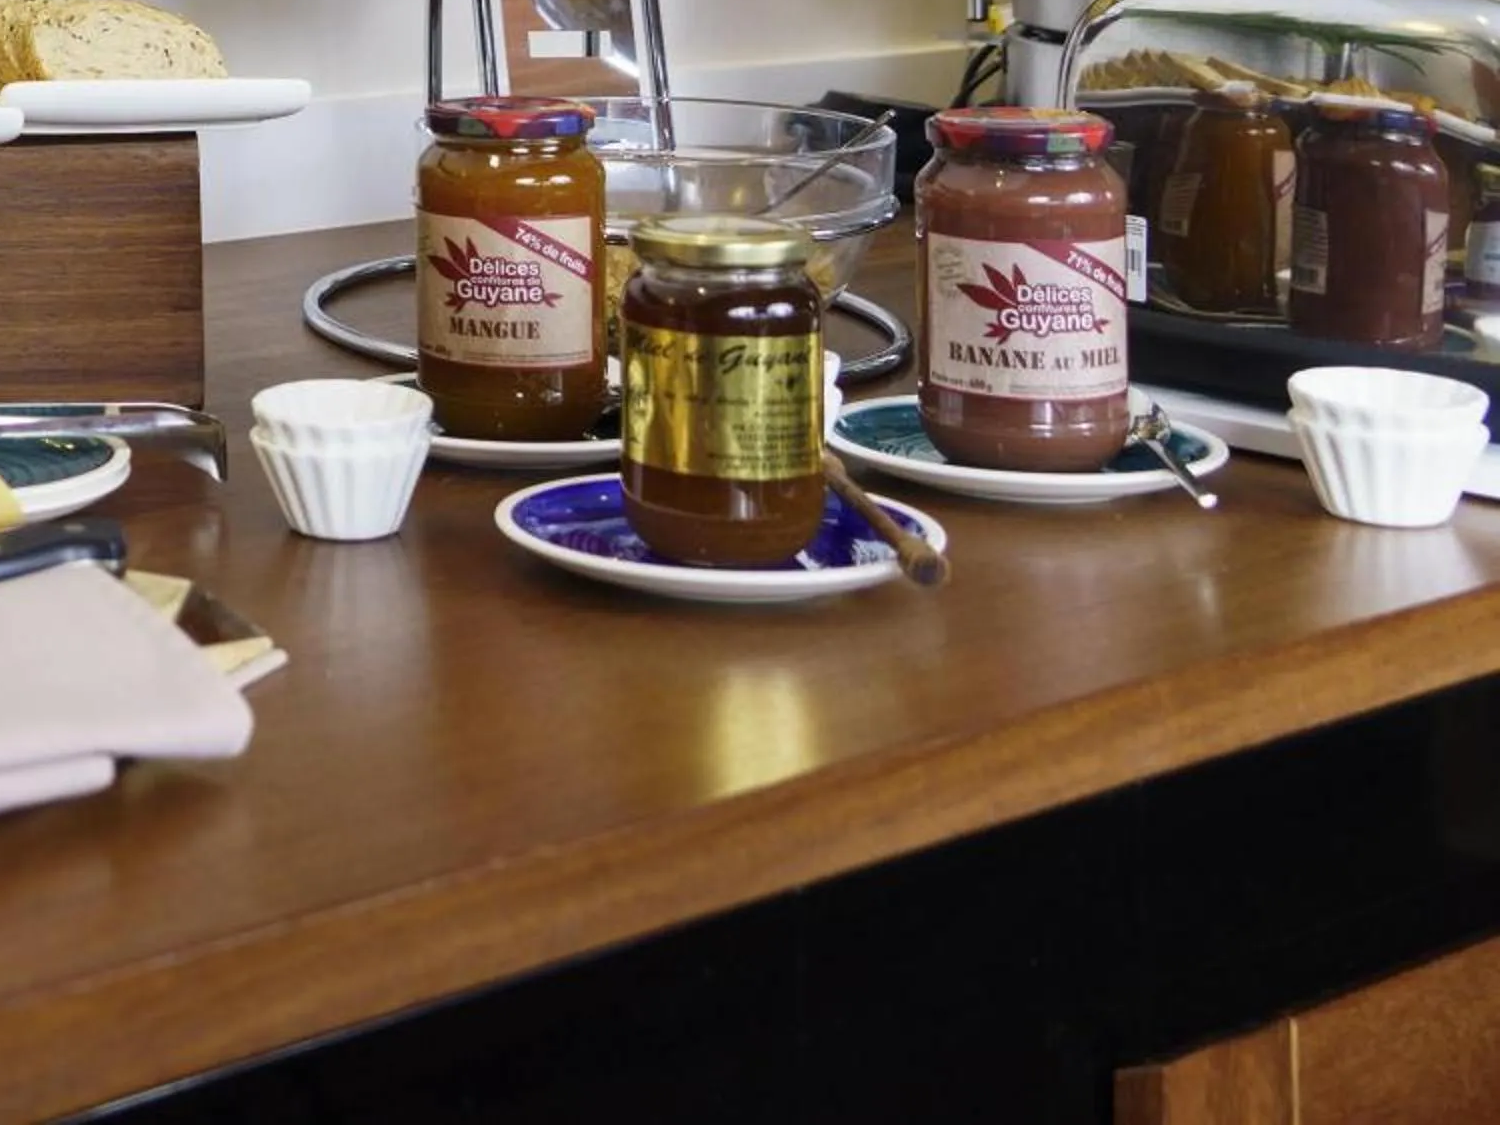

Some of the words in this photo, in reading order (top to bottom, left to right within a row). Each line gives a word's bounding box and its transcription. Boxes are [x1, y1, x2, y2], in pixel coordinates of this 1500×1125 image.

[542, 244, 559, 260] de
[469, 257, 540, 275] Délices
[456, 278, 543, 305] Guyane
[1016, 283, 1092, 303] Délices
[449, 316, 541, 340] MANGUE
[1000, 308, 1094, 335] Guyane
[948, 341, 1045, 370] BANANE
[1051, 356, 1074, 370] AU
[1081, 346, 1119, 368] MIEL
